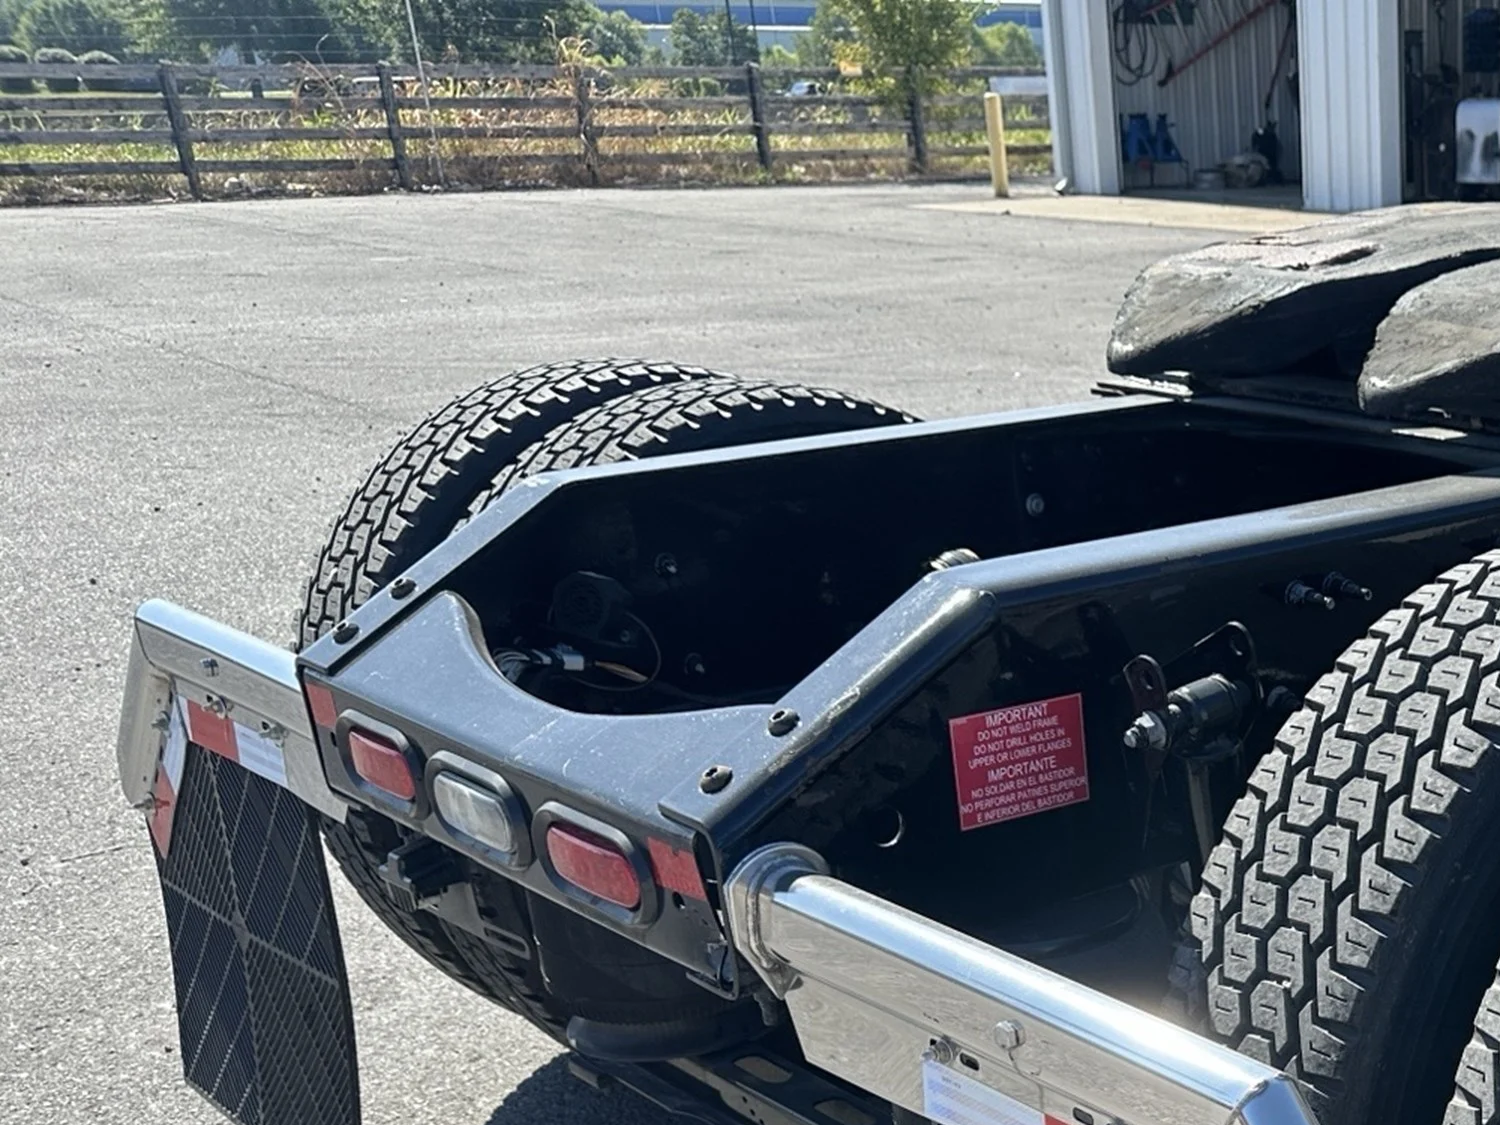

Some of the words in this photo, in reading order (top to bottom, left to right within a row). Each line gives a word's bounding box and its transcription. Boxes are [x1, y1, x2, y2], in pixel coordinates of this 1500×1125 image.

[977, 730, 991, 742] DO
[991, 725, 1008, 738] NOT
[1009, 720, 1031, 734] WELD
[1032, 715, 1059, 729] FRAME
[986, 703, 1048, 728] IMPORTANT
[968, 755, 996, 769] UPPER
[996, 752, 1009, 763] OR
[1009, 745, 1037, 760] LOWER
[1038, 737, 1072, 753] FLANGES
[973, 743, 987, 756] DO
[987, 740, 1004, 752] NOT
[1005, 735, 1028, 749] DRILL
[1029, 729, 1056, 742] HOLES
[1056, 727, 1066, 737] IN
[971, 788, 984, 799] NO
[984, 779, 1016, 796] SOLDAR
[1016, 778, 1027, 788] EN
[1028, 776, 1037, 786] EL
[1038, 766, 1075, 783] BASTIDOR
[988, 755, 1057, 782] IMPORTANTE
[960, 802, 974, 814] NO
[974, 792, 1016, 811] PERFORAR
[1017, 785, 1049, 800] PATINES
[1050, 775, 1087, 792] SUPERIOR
[977, 811, 984, 823] E
[984, 803, 1020, 818] INFERIOR
[1021, 800, 1036, 811] DEL
[1037, 791, 1074, 808] BASTIDOR
